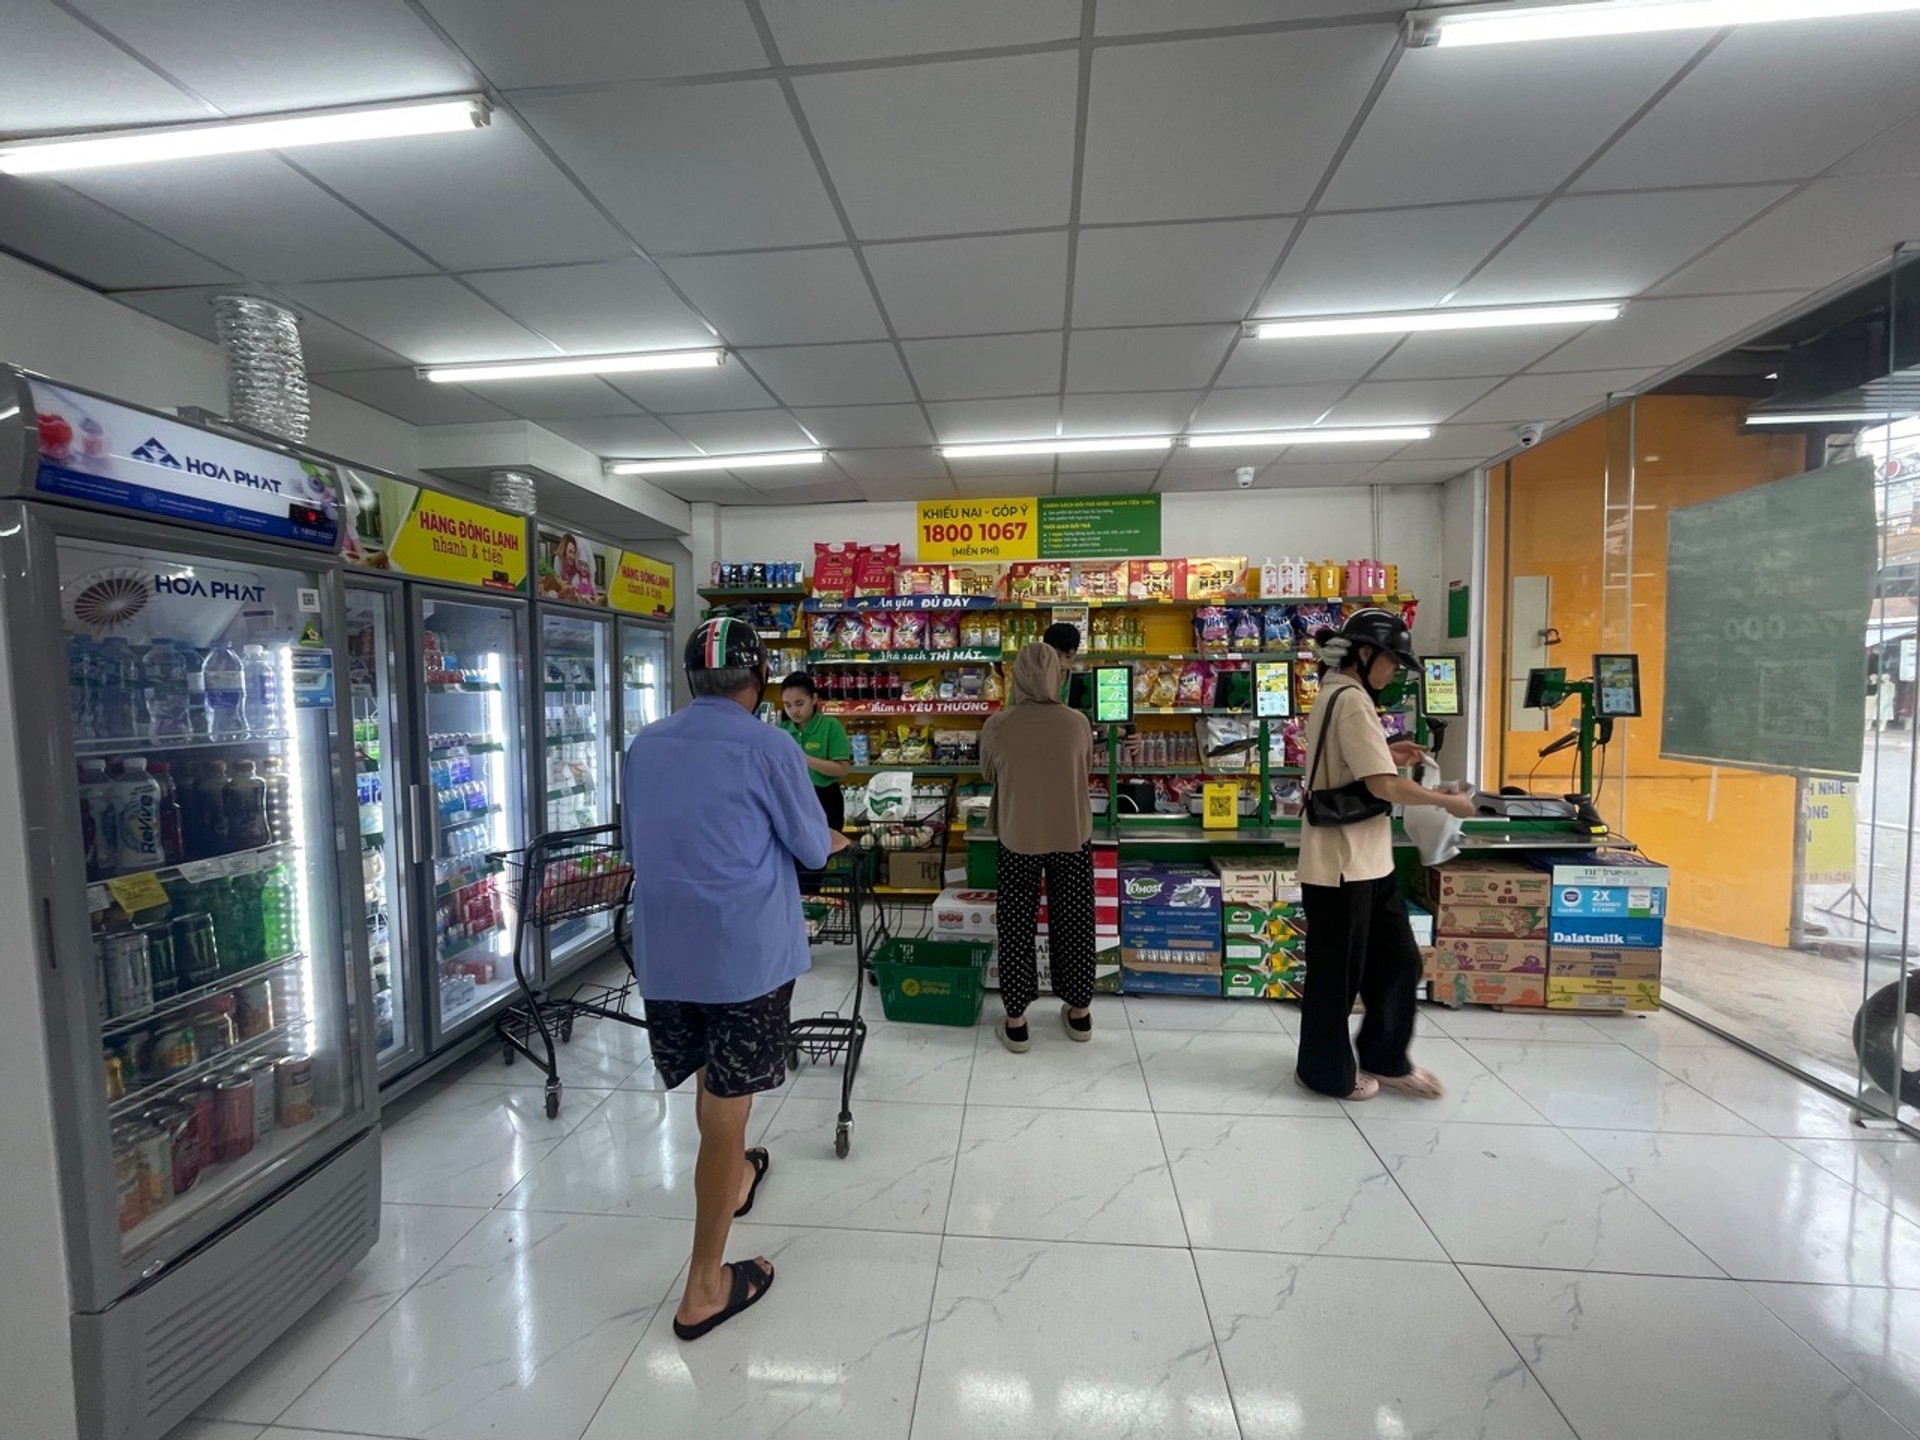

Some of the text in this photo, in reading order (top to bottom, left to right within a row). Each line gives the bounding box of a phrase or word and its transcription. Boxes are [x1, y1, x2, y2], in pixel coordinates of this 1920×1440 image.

[923, 504, 959, 519] KHIẾU
[961, 507, 982, 520] NẠI
[992, 504, 1018, 517] GÓP
[1020, 503, 1029, 516] Ý
[419, 509, 519, 551] HÀNG ĐÔNG LẠNH
[923, 524, 973, 543] 1800
[979, 522, 1028, 541] 1067
[432, 536, 504, 567] nhanh & tiện
[952, 545, 999, 557] (MIỄN PHÍ)
[821, 577, 844, 585] ST25
[211, 581, 266, 603] PHÁT
[902, 650, 927, 661] sạch
[929, 649, 950, 660] THÌ
[909, 701, 933, 712] YÊU
[936, 700, 990, 712] THƯƠNG
[1591, 890, 1610, 902] 2X
[1553, 932, 1625, 944] Dalatmilk
